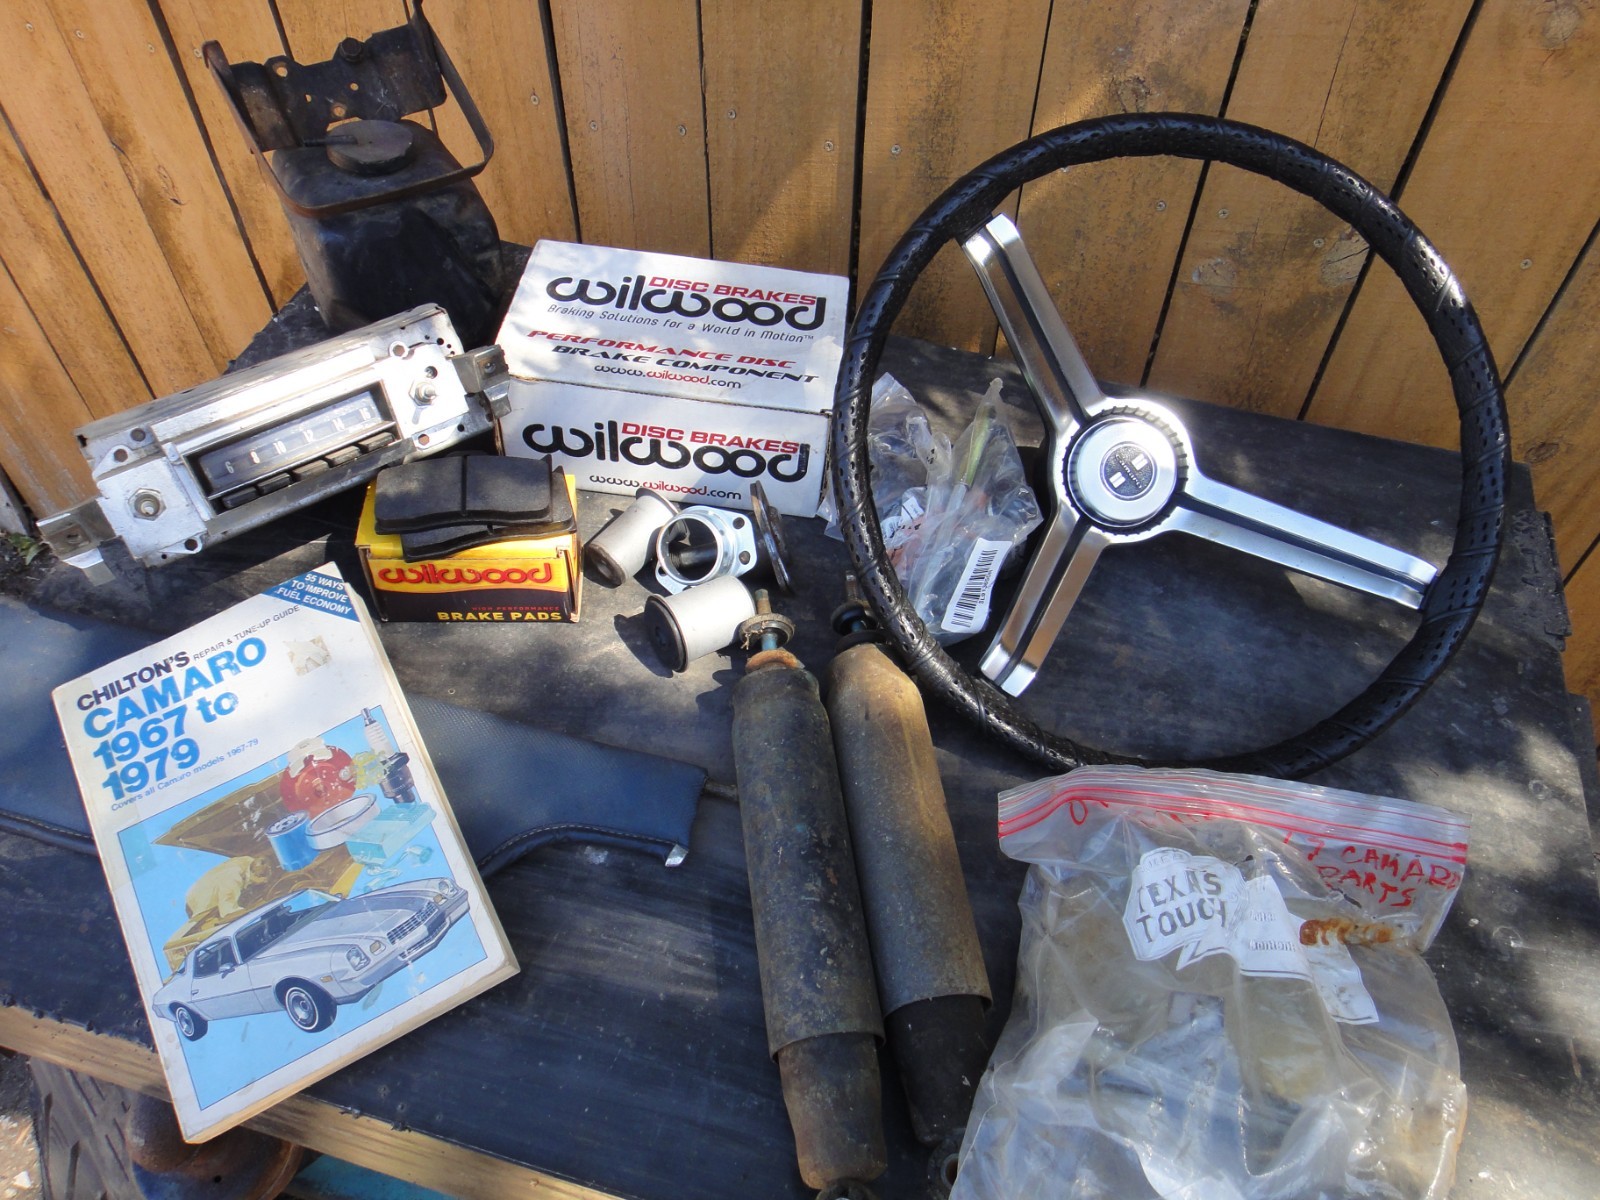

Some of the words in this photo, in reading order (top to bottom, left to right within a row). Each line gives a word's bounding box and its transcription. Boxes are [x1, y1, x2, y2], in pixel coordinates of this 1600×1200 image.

[546, 275, 827, 331] wilwood
[649, 276, 709, 292] DISC
[713, 285, 817, 306] BRAKES
[547, 303, 595, 319] Braking
[600, 310, 659, 327] Solutions
[663, 318, 683, 330] for
[687, 323, 694, 331] a
[702, 323, 740, 337] World
[745, 329, 756, 338] in
[527, 330, 733, 363] PERFORMANCE
[737, 355, 797, 369] DISC
[551, 345, 649, 364] BRAKE
[656, 356, 820, 384] COMPONENT
[594, 366, 741, 389] www.wilwood.com
[522, 420, 810, 483] wilwood
[621, 422, 684, 441] DISC
[689, 431, 802, 454] BRAKES
[225, 461, 234, 474] 6
[250, 450, 260, 464] 8
[273, 440, 287, 455] 10
[589, 473, 742, 501] www.wilwood.com
[291, 580, 305, 590] TO
[305, 584, 349, 603] IMPROVE
[305, 573, 318, 582] 55
[318, 576, 345, 591] WAYS
[378, 563, 552, 585] wilwood
[277, 587, 300, 600] FUEL
[303, 595, 352, 615] ECONOMY
[437, 612, 504, 621] BRAKE
[510, 612, 562, 621] PADS
[77, 651, 190, 711] CHILTON'S
[193, 641, 225, 661] REPAIR
[226, 638, 234, 647] &
[234, 618, 272, 640] TUNE-UP
[273, 604, 300, 622] GUIDE
[83, 637, 267, 739] CAMARO
[93, 707, 188, 770] 1967
[196, 691, 239, 724] to
[102, 737, 201, 801] 1979
[111, 794, 143, 811] Covers
[145, 785, 156, 797] all
[193, 755, 225, 774] models
[227, 738, 260, 758] 1967-79
[1137, 870, 1223, 914] TEXAS
[1315, 865, 1417, 907] PARTS
